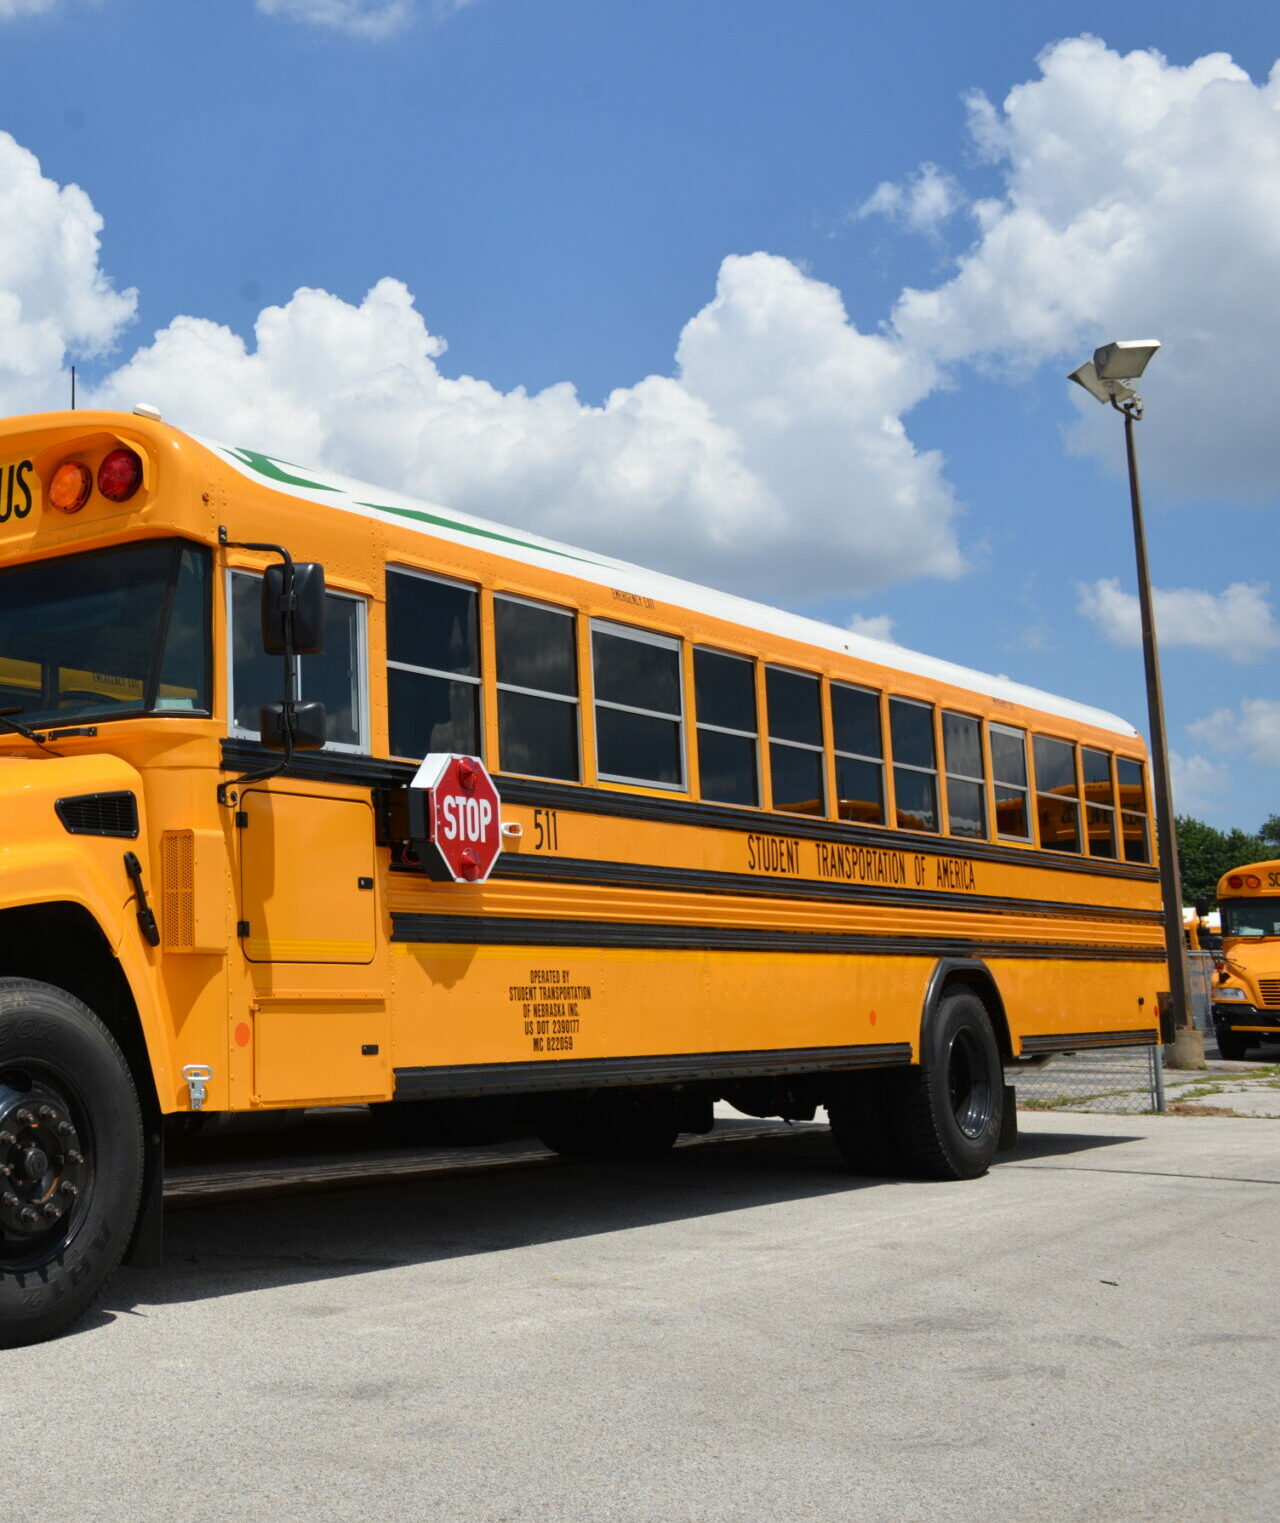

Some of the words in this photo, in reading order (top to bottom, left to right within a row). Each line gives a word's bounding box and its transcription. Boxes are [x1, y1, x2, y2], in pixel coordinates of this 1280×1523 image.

[443, 795, 492, 843] STOP
[534, 809, 558, 850] 511
[748, 834, 800, 875] STUDENT
[815, 843, 906, 885] TRANSPORTATION
[914, 855, 926, 886] OF
[937, 858, 976, 890] AMERICA
[530, 970, 560, 984] OPERATED
[562, 970, 569, 983] BY
[509, 986, 536, 1001] STUDENT
[539, 986, 592, 1000] TRANSPORTATION
[523, 1003, 530, 1018] OF
[533, 1003, 565, 1018] NEBRASKA
[568, 1003, 580, 1017] INC.
[525, 1021, 533, 1035] US
[537, 1020, 549, 1034] DOT
[552, 1019, 580, 1034] 2390177
[533, 1037, 543, 1052] MC
